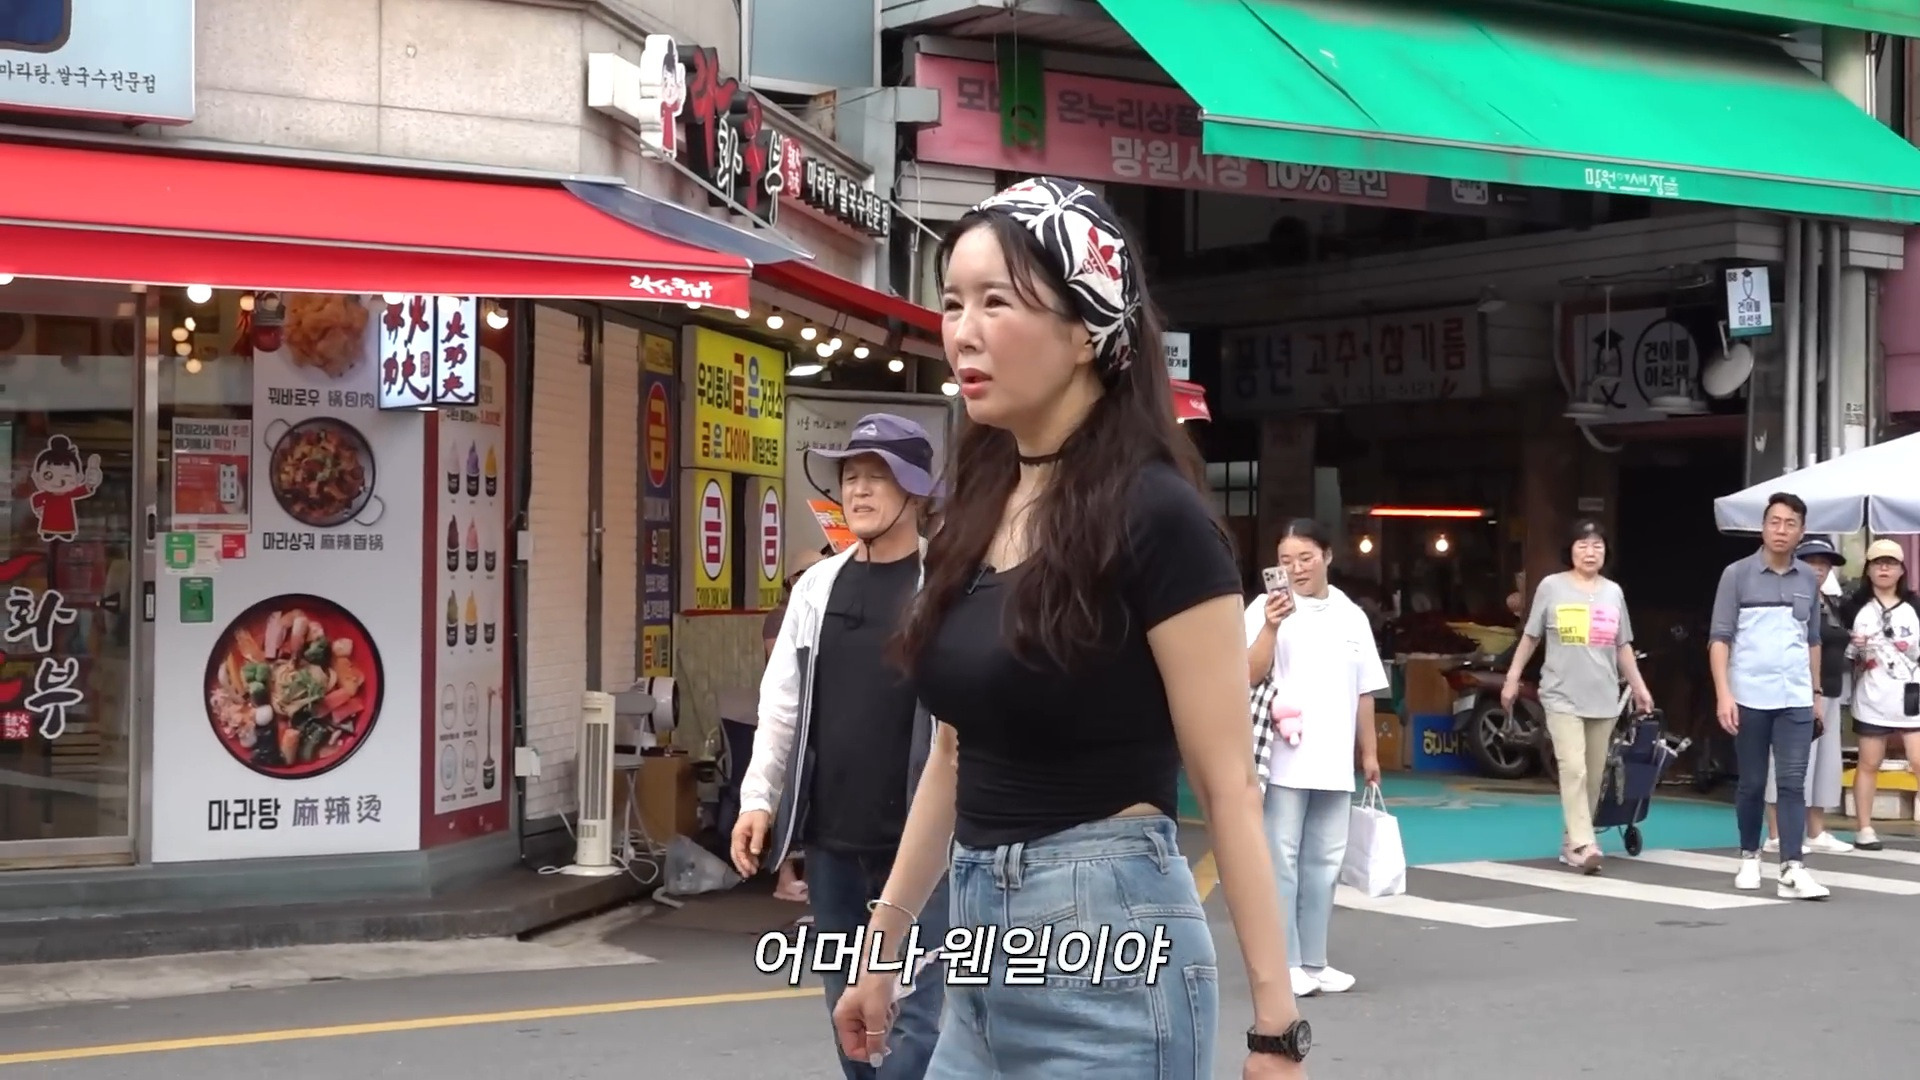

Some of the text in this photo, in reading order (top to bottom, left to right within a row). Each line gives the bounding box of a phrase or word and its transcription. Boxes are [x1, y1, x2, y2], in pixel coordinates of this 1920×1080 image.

[1264, 161, 1331, 192] 10%
[1337, 169, 1388, 197] 할인
[704, 496, 723, 564] 금
[764, 503, 778, 566] 금
[207, 793, 383, 831] 마라탕 麻辣烫
